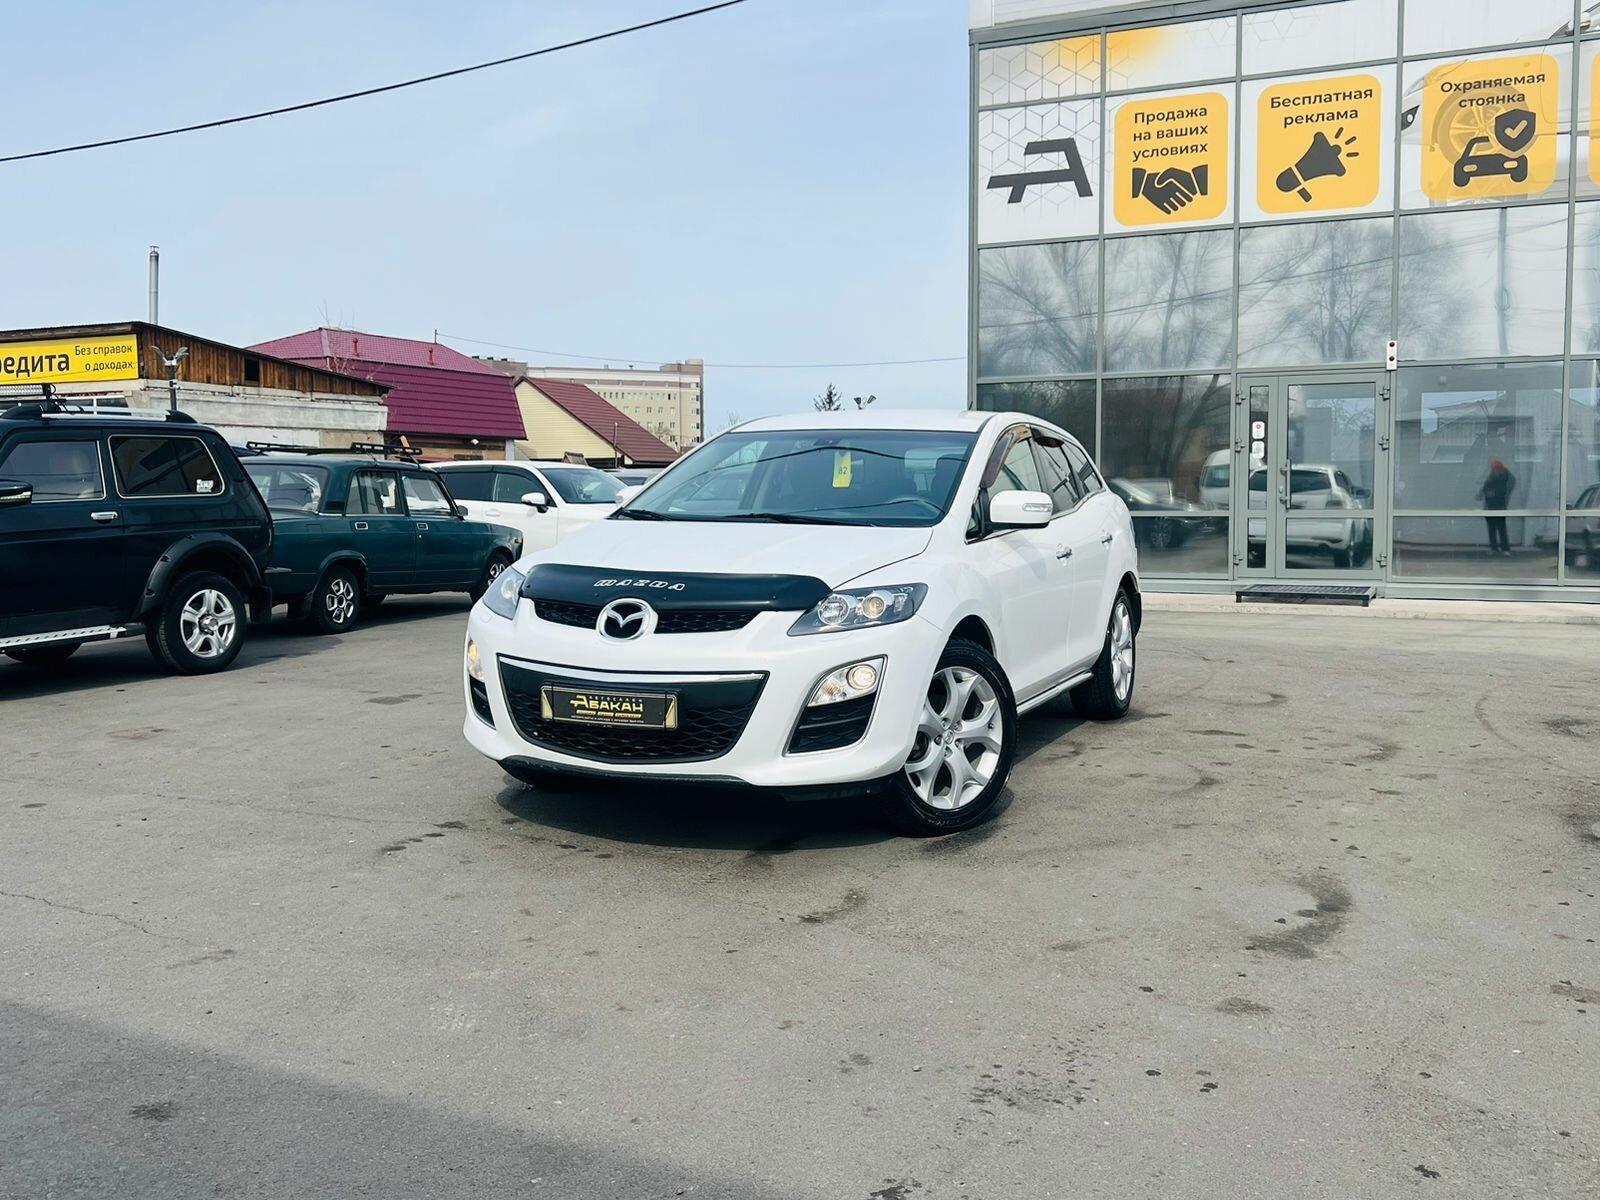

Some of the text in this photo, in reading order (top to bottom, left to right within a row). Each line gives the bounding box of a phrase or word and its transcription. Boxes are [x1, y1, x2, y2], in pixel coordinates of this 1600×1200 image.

[1440, 73, 1545, 93] Охраняемая
[1270, 88, 1373, 109] Бесплатная
[1458, 93, 1525, 108] стоянка
[1134, 107, 1207, 125] Продажа
[1283, 109, 1358, 128] реклама
[1133, 125, 1208, 142] на ваших
[1132, 143, 1208, 163] условиях
[75, 345, 133, 357] Без справок
[85, 360, 133, 372] о доходах
